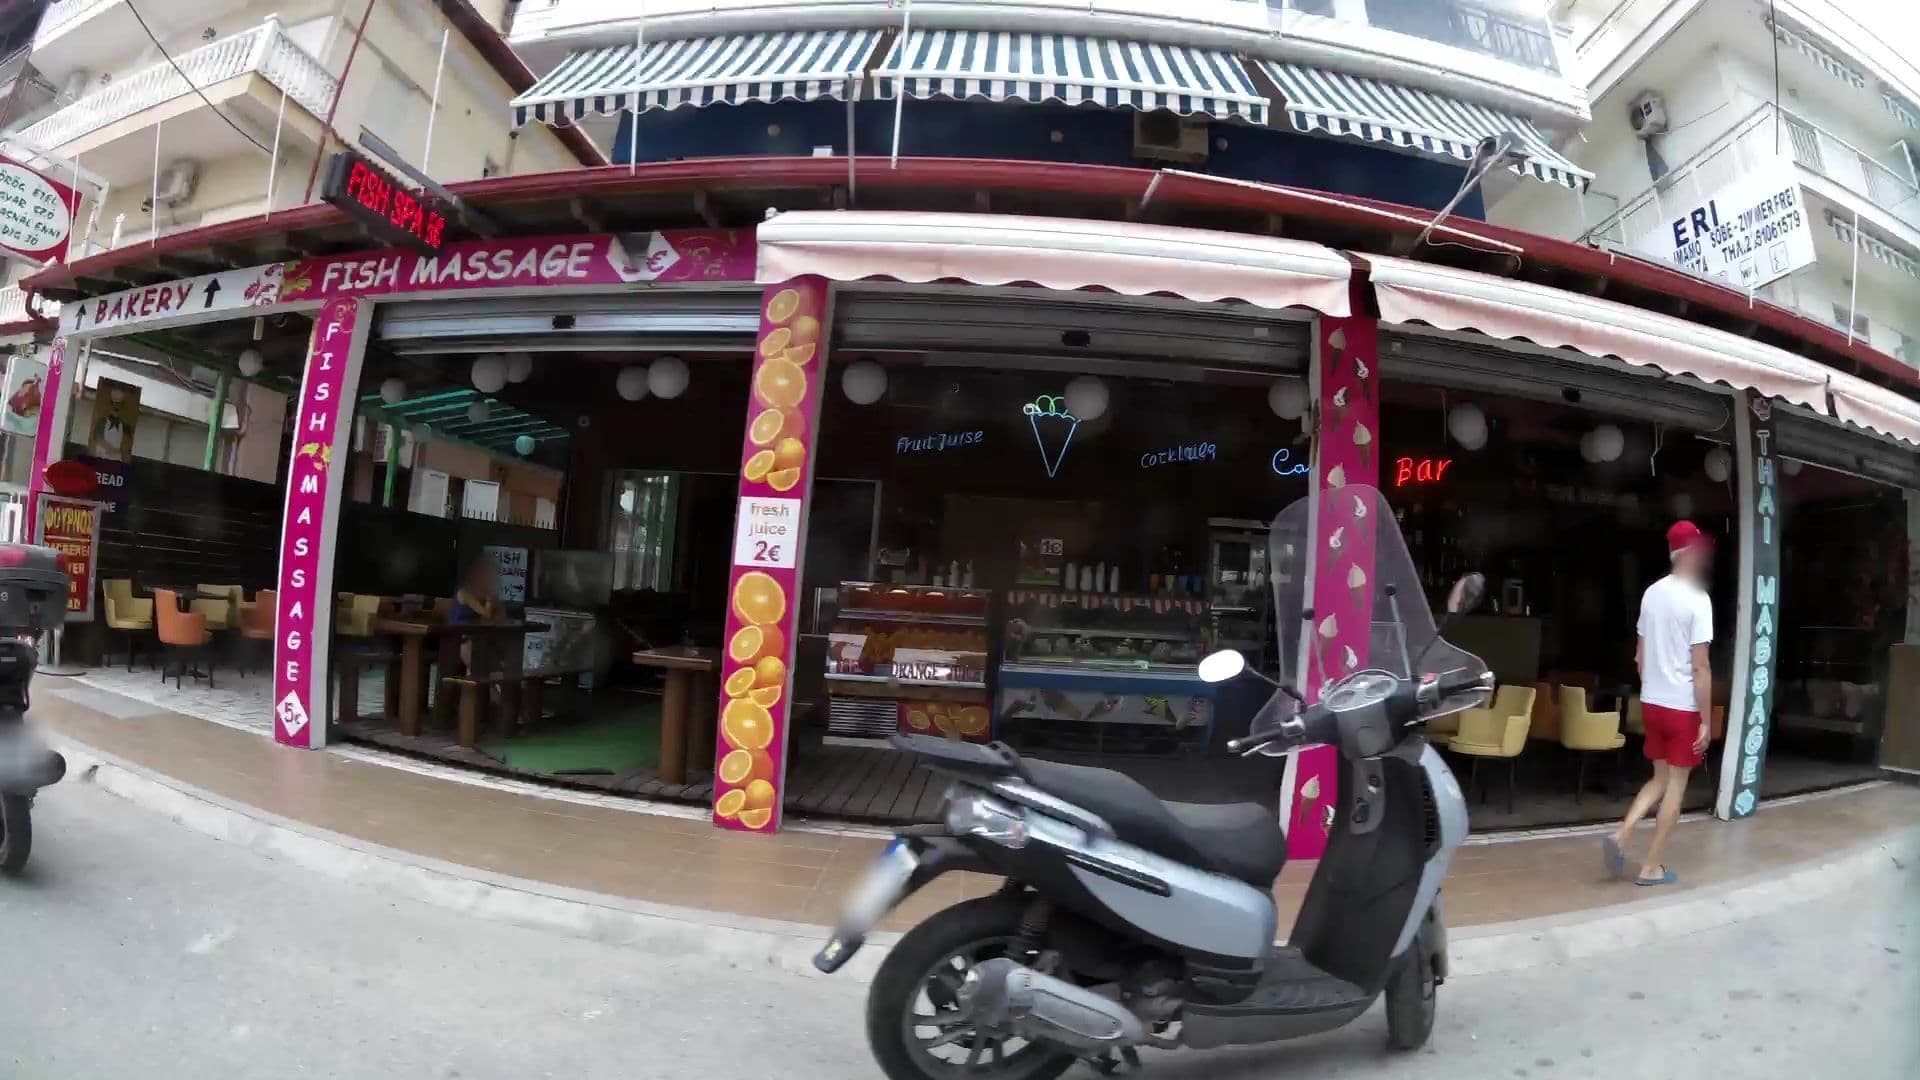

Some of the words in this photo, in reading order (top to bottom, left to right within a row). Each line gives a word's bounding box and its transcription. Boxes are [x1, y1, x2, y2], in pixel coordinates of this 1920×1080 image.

[347, 161, 391, 216] FISH
[1672, 200, 1719, 248] ERI
[321, 255, 400, 291] FISH
[410, 243, 594, 284] MASSAGE
[94, 282, 192, 324] BAKERY
[309, 322, 341, 432] FISH
[96, 471, 124, 487] READ
[1272, 448, 1310, 475] Ca
[1396, 457, 1452, 487] Bar
[1756, 429, 1775, 545] THAI
[748, 522, 786, 537] juice
[751, 502, 789, 517] fresh
[754, 540, 781, 562] 2€
[286, 474, 318, 682] MASSAGE
[1741, 575, 1776, 785] MASSAGE
